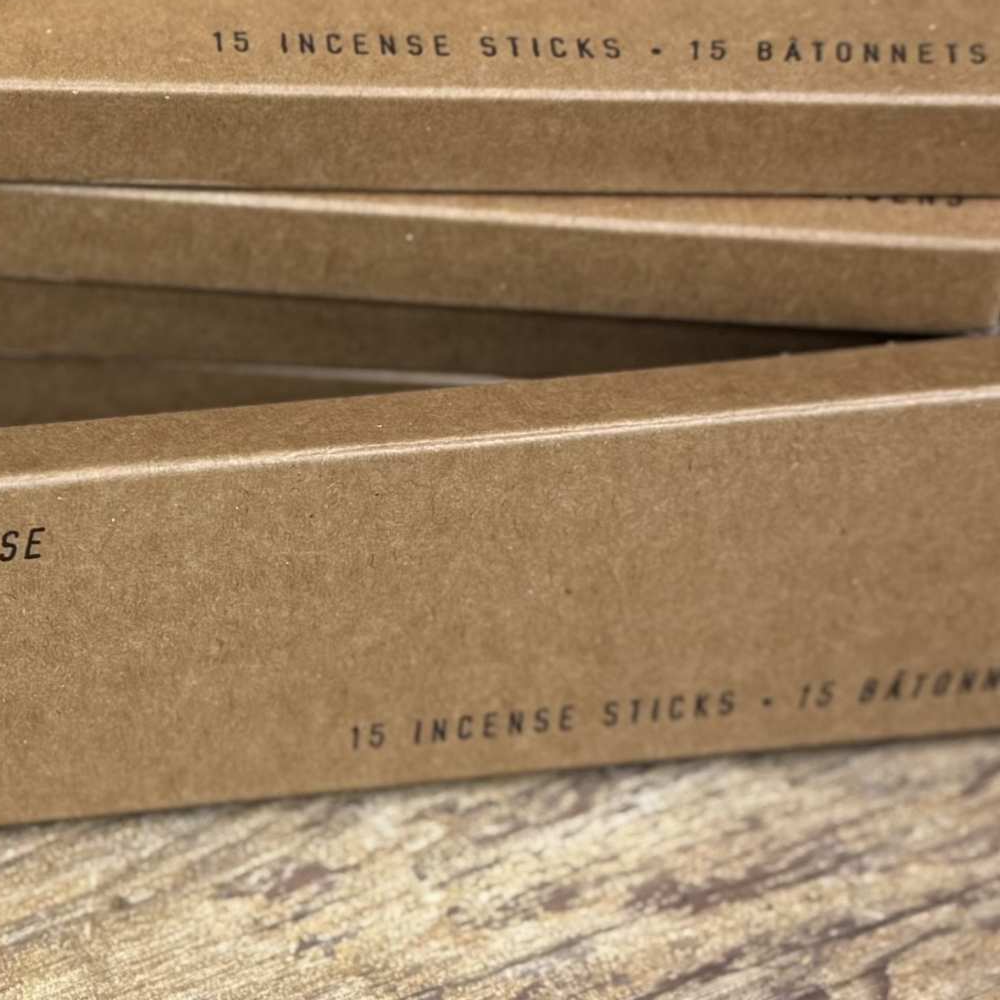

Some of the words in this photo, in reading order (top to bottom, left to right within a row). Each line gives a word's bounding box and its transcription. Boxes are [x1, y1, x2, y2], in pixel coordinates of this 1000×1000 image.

[213, 31, 249, 52] 15
[280, 33, 450, 57] INCENSE
[480, 36, 621, 59] STICKS
[690, 39, 727, 61] 15
[757, 36, 987, 64] BÂTONNETS
[351, 723, 385, 750] 15
[413, 704, 574, 745] INCENSE
[602, 690, 735, 727] STICKS
[799, 680, 835, 709] 15
